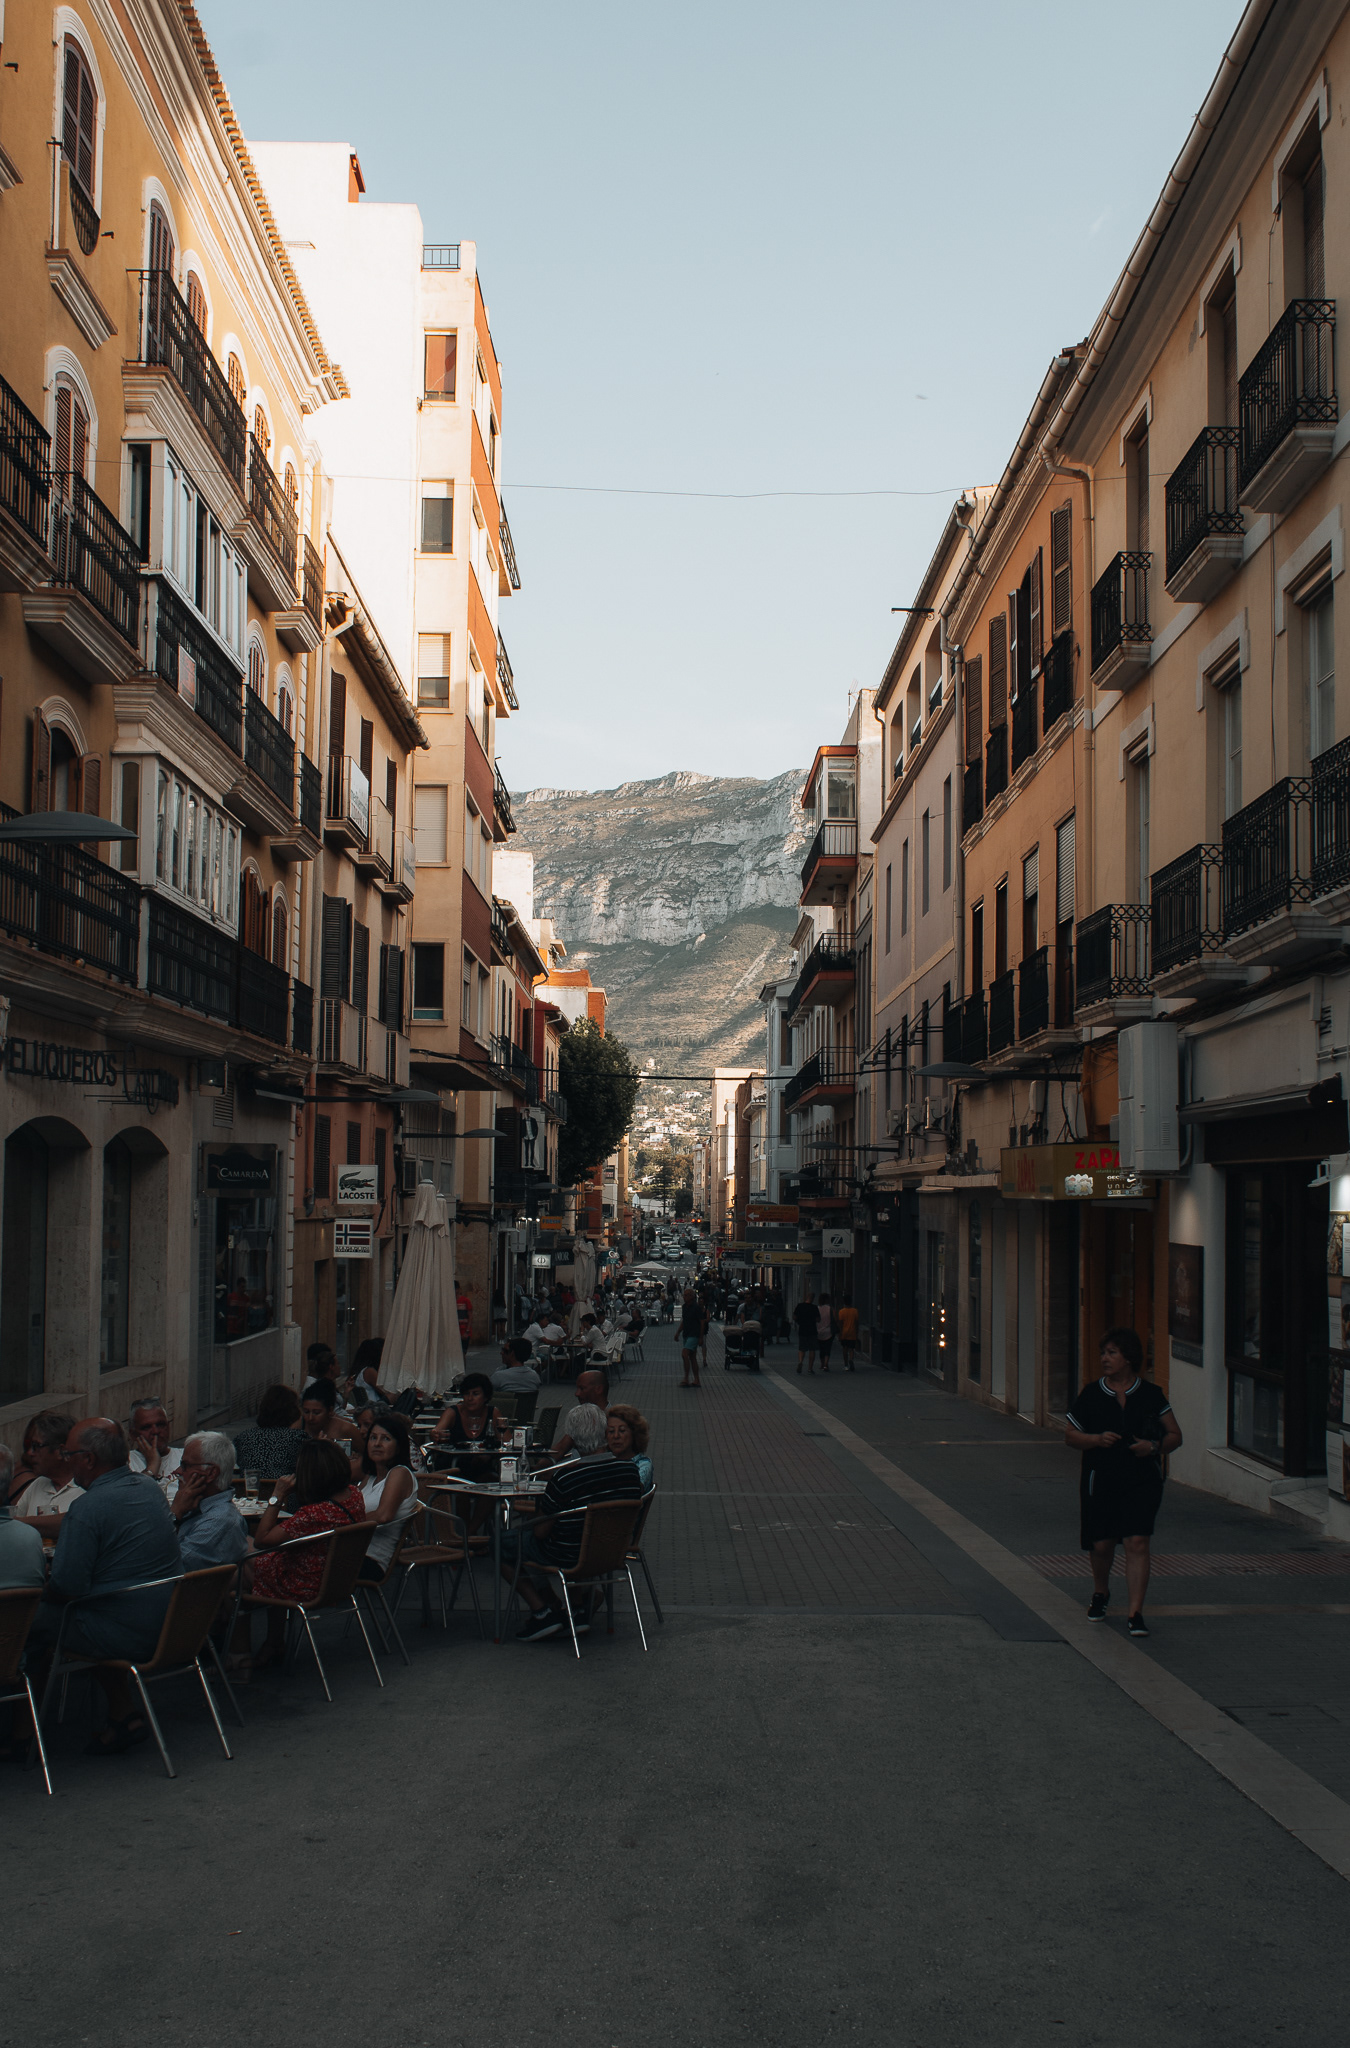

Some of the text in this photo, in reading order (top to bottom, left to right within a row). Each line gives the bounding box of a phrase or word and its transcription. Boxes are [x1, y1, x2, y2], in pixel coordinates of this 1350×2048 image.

[3, 1036, 117, 1086] ELUQUEROS
[1075, 1148, 1119, 1168] ZAPA
[339, 1192, 375, 1200] LACOSTE
